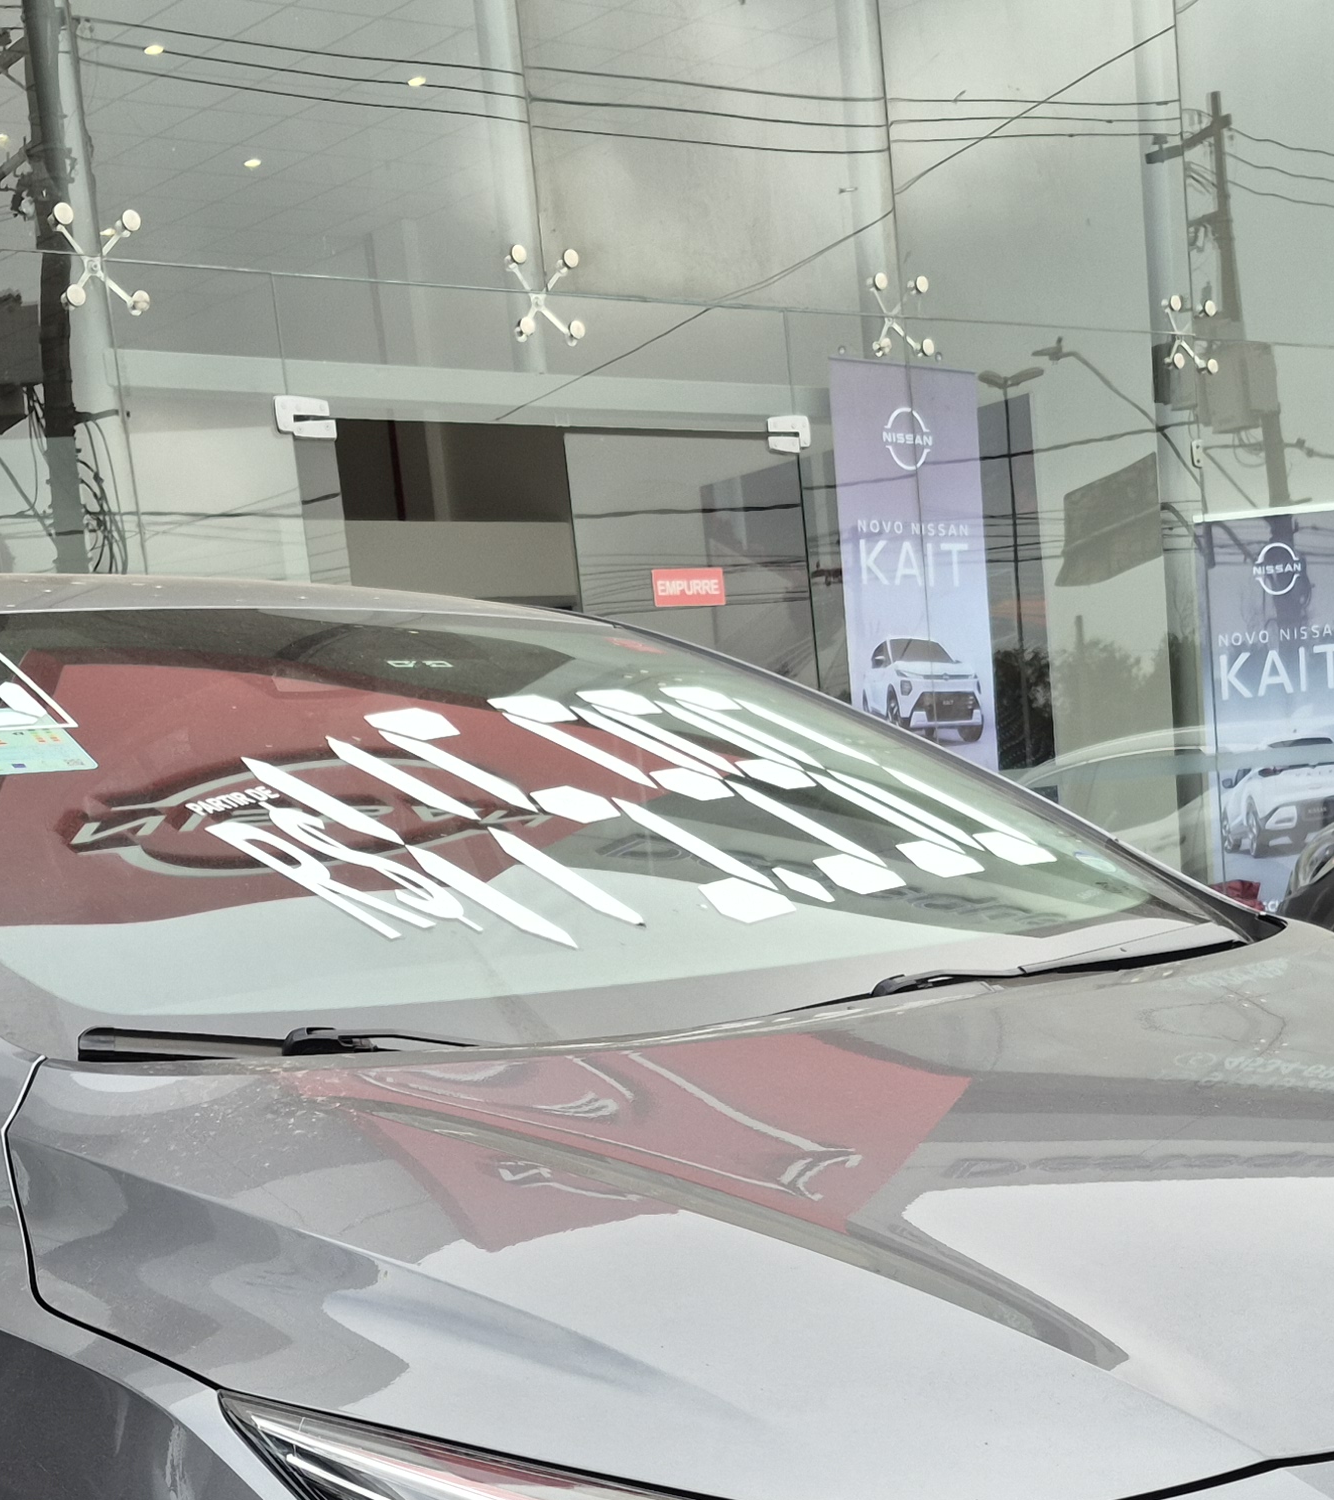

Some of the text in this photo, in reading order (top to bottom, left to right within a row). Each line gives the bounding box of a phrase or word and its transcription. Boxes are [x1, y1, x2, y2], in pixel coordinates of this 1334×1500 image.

[882, 430, 933, 447] NISSAN
[857, 519, 969, 537] NOVO NISSAN
[858, 538, 969, 588] KAIT
[1253, 561, 1302, 576] NISSAN
[656, 579, 720, 596] EMPURRE
[1218, 630, 1269, 648] NOVO
[185, 785, 281, 817] PARTIR DE
